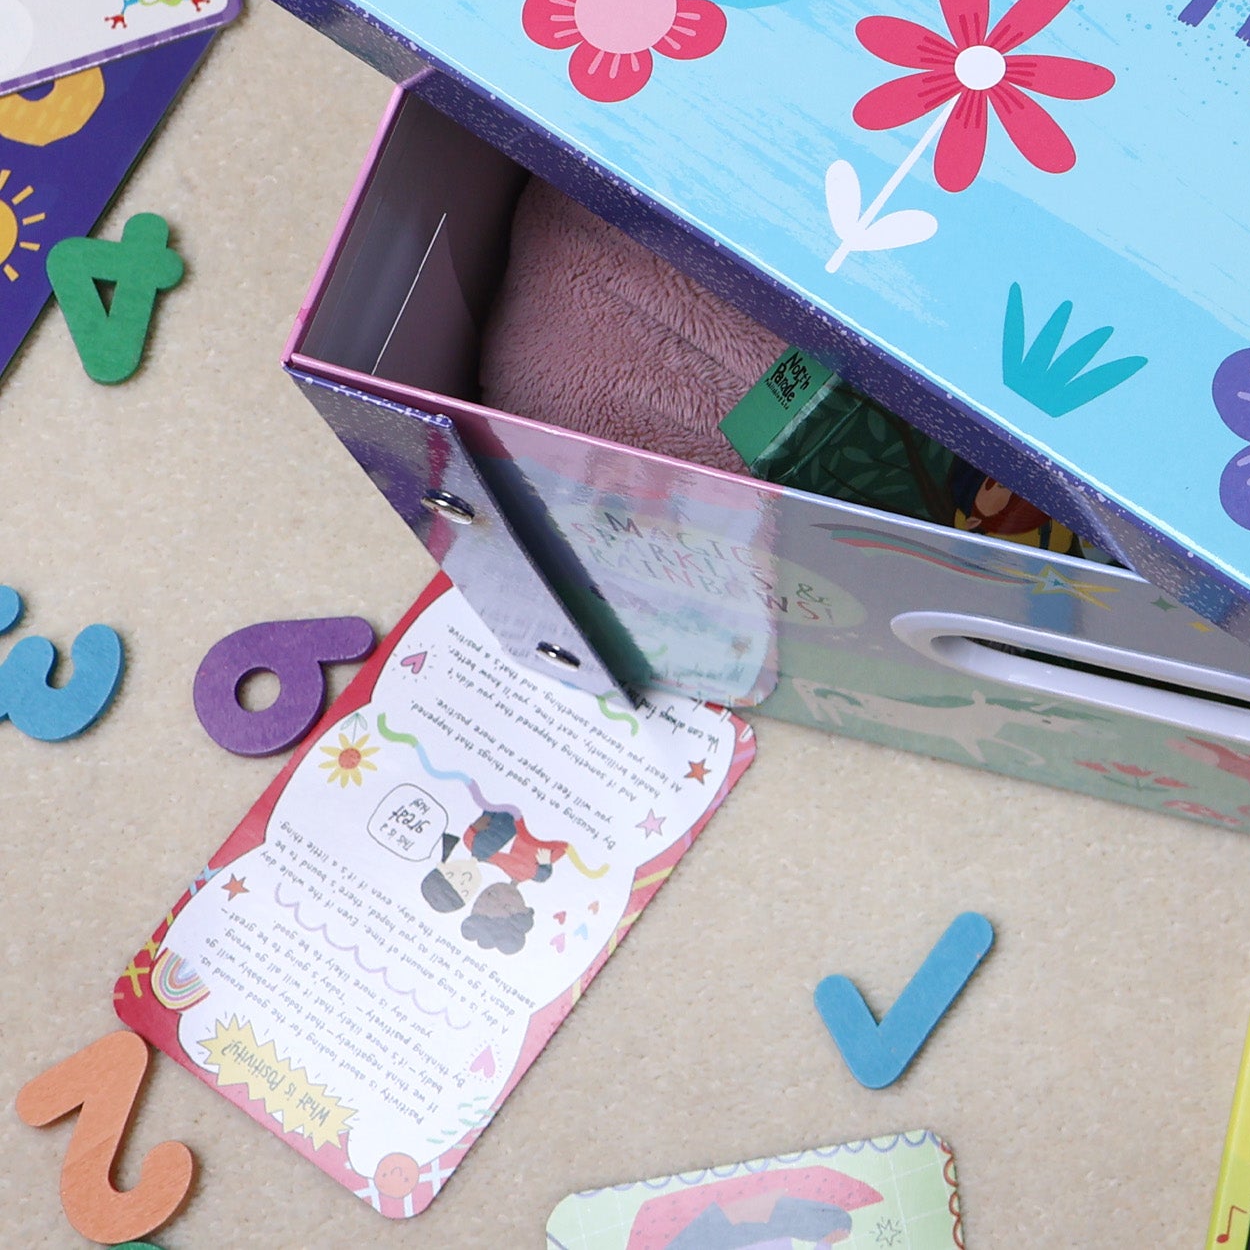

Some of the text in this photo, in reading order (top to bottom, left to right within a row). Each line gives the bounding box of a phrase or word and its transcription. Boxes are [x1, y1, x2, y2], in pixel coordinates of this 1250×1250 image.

[785, 351, 811, 390] North
[770, 362, 799, 402] Parade
[478, 668, 501, 688] know
[519, 677, 538, 691] and
[476, 687, 494, 700] you
[494, 700, 513, 717] that
[658, 705, 685, 734] always
[473, 725, 496, 744] more
[514, 714, 558, 748] happened
[556, 723, 578, 739] next
[588, 725, 624, 753] learned
[686, 726, 703, 738] can
[454, 733, 474, 750] that
[496, 743, 515, 756] and
[707, 734, 719, 753] We
[476, 748, 504, 771] things
[560, 743, 606, 779] something
[626, 751, 645, 764] you
[504, 769, 530, 786] good
[517, 757, 550, 784] happier
[644, 764, 669, 784] least
[551, 781, 571, 799] feel
[605, 778, 617, 788] if
[630, 772, 660, 799] handle
[670, 781, 682, 793] At
[531, 785, 546, 801] the
[617, 786, 636, 802] And
[549, 798, 560, 809] on
[572, 796, 591, 810] will
[387, 805, 430, 833] great
[562, 806, 599, 839] focusing
[593, 810, 613, 823] you
[386, 827, 397, 840] is
[602, 834, 616, 850] By
[274, 839, 286, 853] be
[395, 834, 415, 851] This
[259, 850, 277, 865] day
[288, 850, 298, 861] to
[306, 841, 329, 862] little
[279, 864, 304, 886] whole
[298, 859, 327, 882] bound
[307, 885, 323, 901] the
[356, 880, 368, 890] if
[323, 899, 334, 909] if
[371, 887, 392, 905] even
[228, 911, 257, 932] great
[336, 906, 359, 927] Even
[256, 930, 268, 945] be
[397, 929, 417, 943] you
[417, 921, 433, 937] the
[205, 937, 219, 948] go
[271, 941, 281, 953] to
[297, 939, 310, 953] be
[385, 943, 399, 953] of
[417, 942, 428, 953] as
[434, 934, 461, 955] about
[216, 947, 235, 963] will
[254, 951, 269, 962] go
[283, 948, 311, 971] going
[312, 949, 322, 961] to
[428, 952, 450, 970] well
[461, 954, 488, 972] good
[266, 962, 281, 973] all
[324, 957, 350, 982] likely
[399, 953, 434, 979] amount
[452, 968, 464, 979] as
[211, 966, 244, 991] around
[237, 960, 278, 992] probably
[282, 973, 300, 989] will
[466, 978, 481, 990] go
[302, 987, 312, 998] it
[352, 978, 376, 999] more
[436, 977, 457, 998] long
[488, 970, 536, 1008] something
[244, 991, 270, 1008] good
[277, 990, 303, 1014] today
[313, 995, 334, 1014] that
[377, 997, 388, 1009] is
[468, 1000, 478, 1013] is
[270, 1007, 286, 1023] the
[304, 1011, 325, 1030] that
[390, 1005, 408, 1022] day
[480, 1009, 498, 1026] day
[288, 1022, 302, 1037] for
[335, 1010, 362, 1035] likely
[364, 1008, 412, 1045] positively
[409, 1022, 433, 1038] your
[501, 1024, 508, 1034] A
[305, 1031, 337, 1061] looking
[334, 1032, 383, 1070] negatively
[365, 1032, 388, 1053] more
[411, 1042, 449, 1076] thinking
[338, 1058, 366, 1080] about
[220, 1039, 331, 1127] What is Positivity?
[368, 1079, 377, 1091] is
[384, 1069, 409, 1092] think
[417, 1069, 443, 1094] badly
[451, 1072, 465, 1088] By
[412, 1088, 425, 1102] we
[379, 1086, 424, 1125] Positivity
[426, 1101, 438, 1113] If
